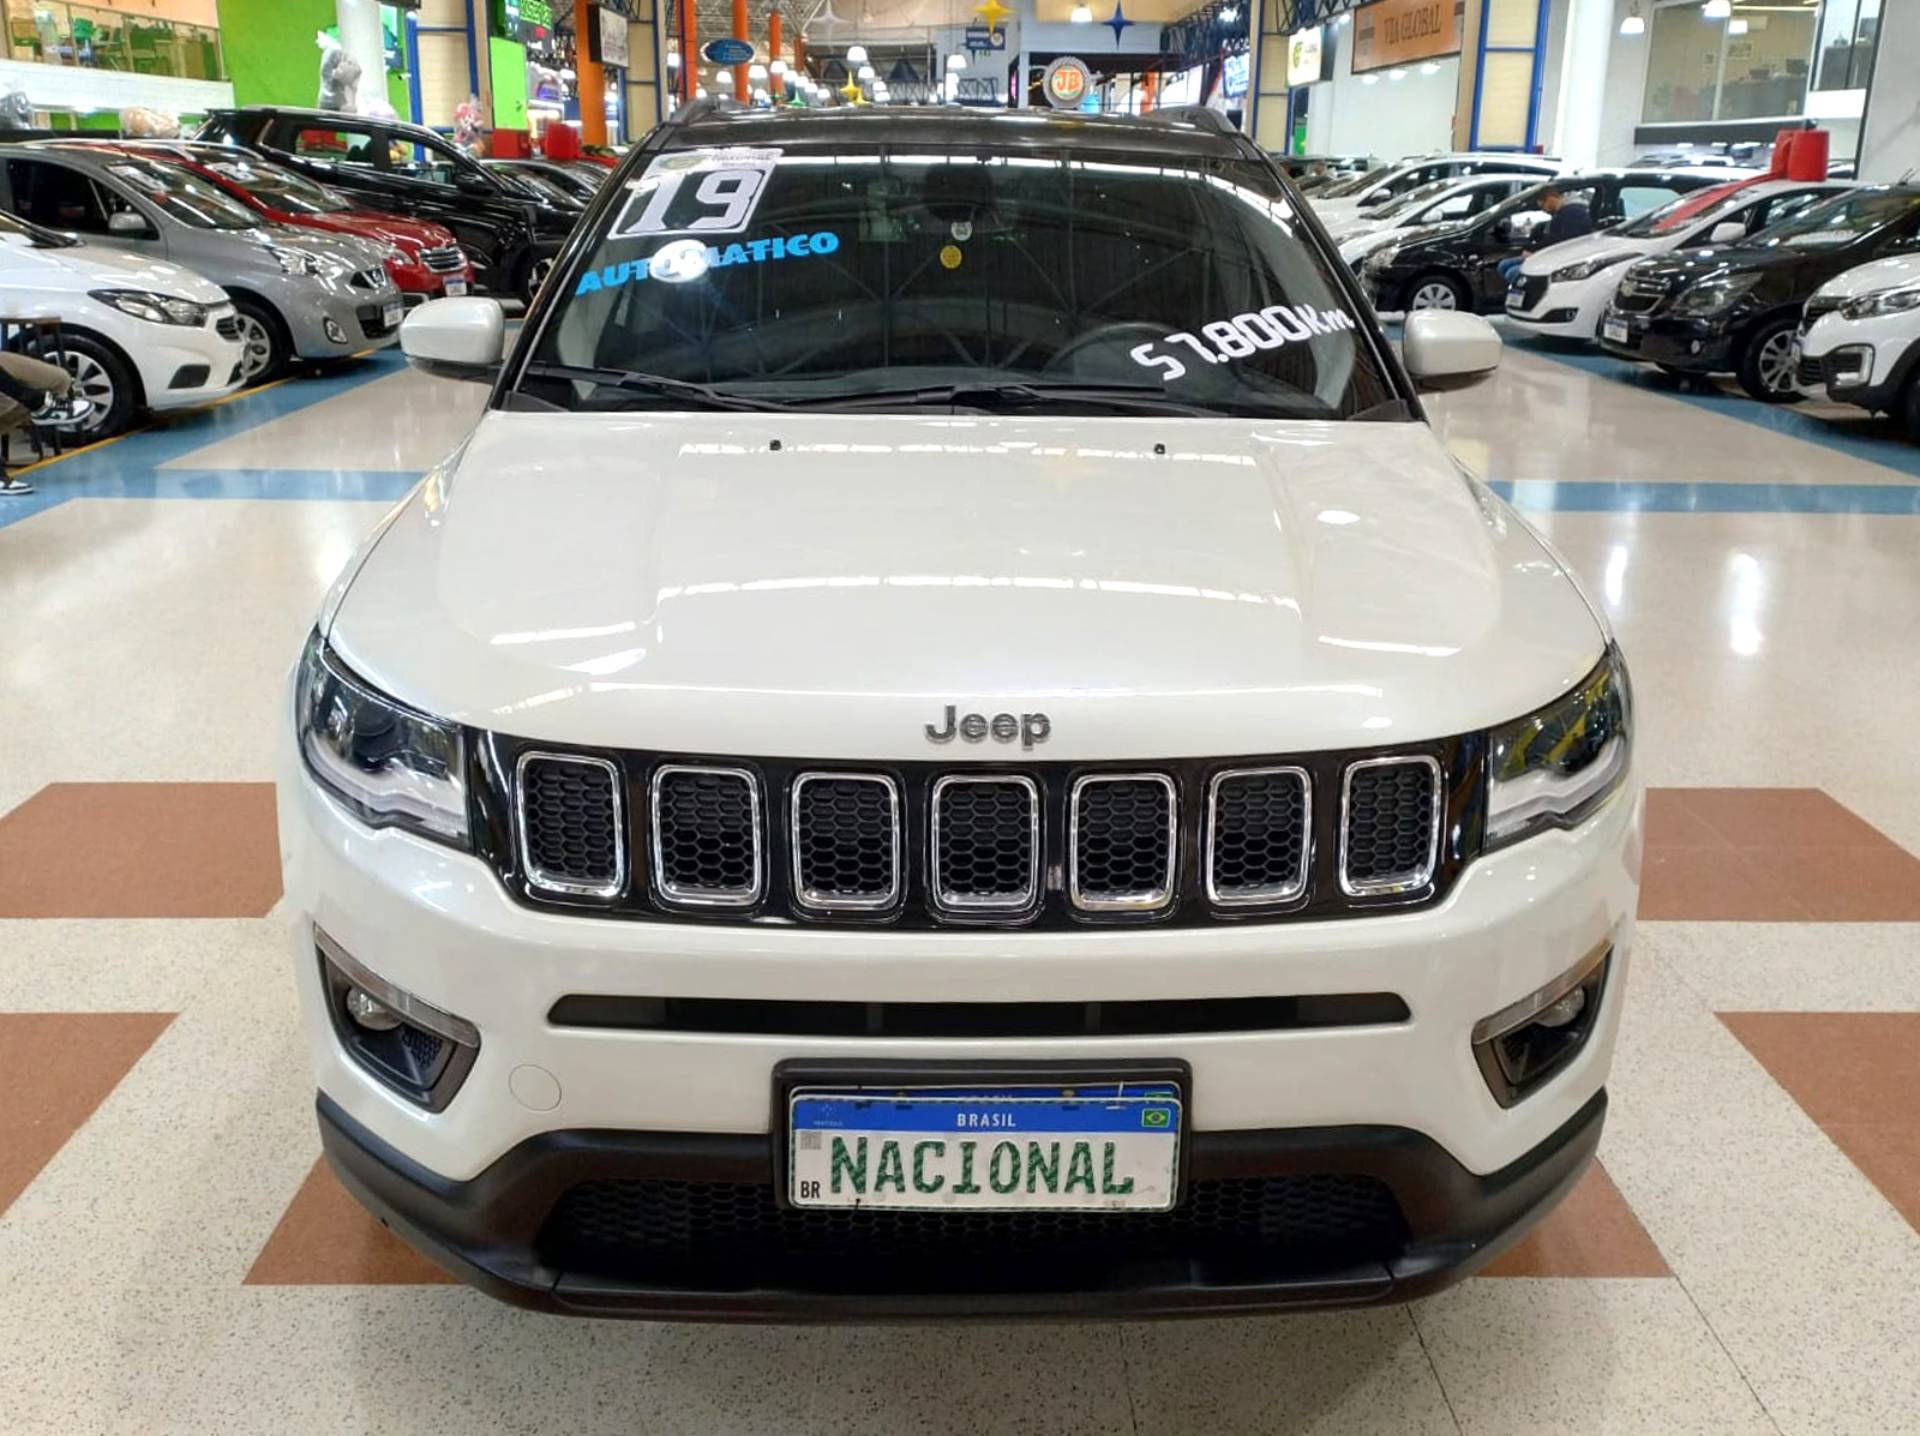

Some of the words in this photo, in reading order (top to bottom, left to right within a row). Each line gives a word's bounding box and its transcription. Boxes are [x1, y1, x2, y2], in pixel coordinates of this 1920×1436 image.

[1401, 4, 1441, 43] GLOBAL
[623, 168, 764, 234] 19
[924, 704, 1051, 750] Jeep
[956, 1112, 1017, 1128] BRASIL
[830, 1136, 1135, 1195] NACIONAL
[800, 1180, 821, 1200] BR
